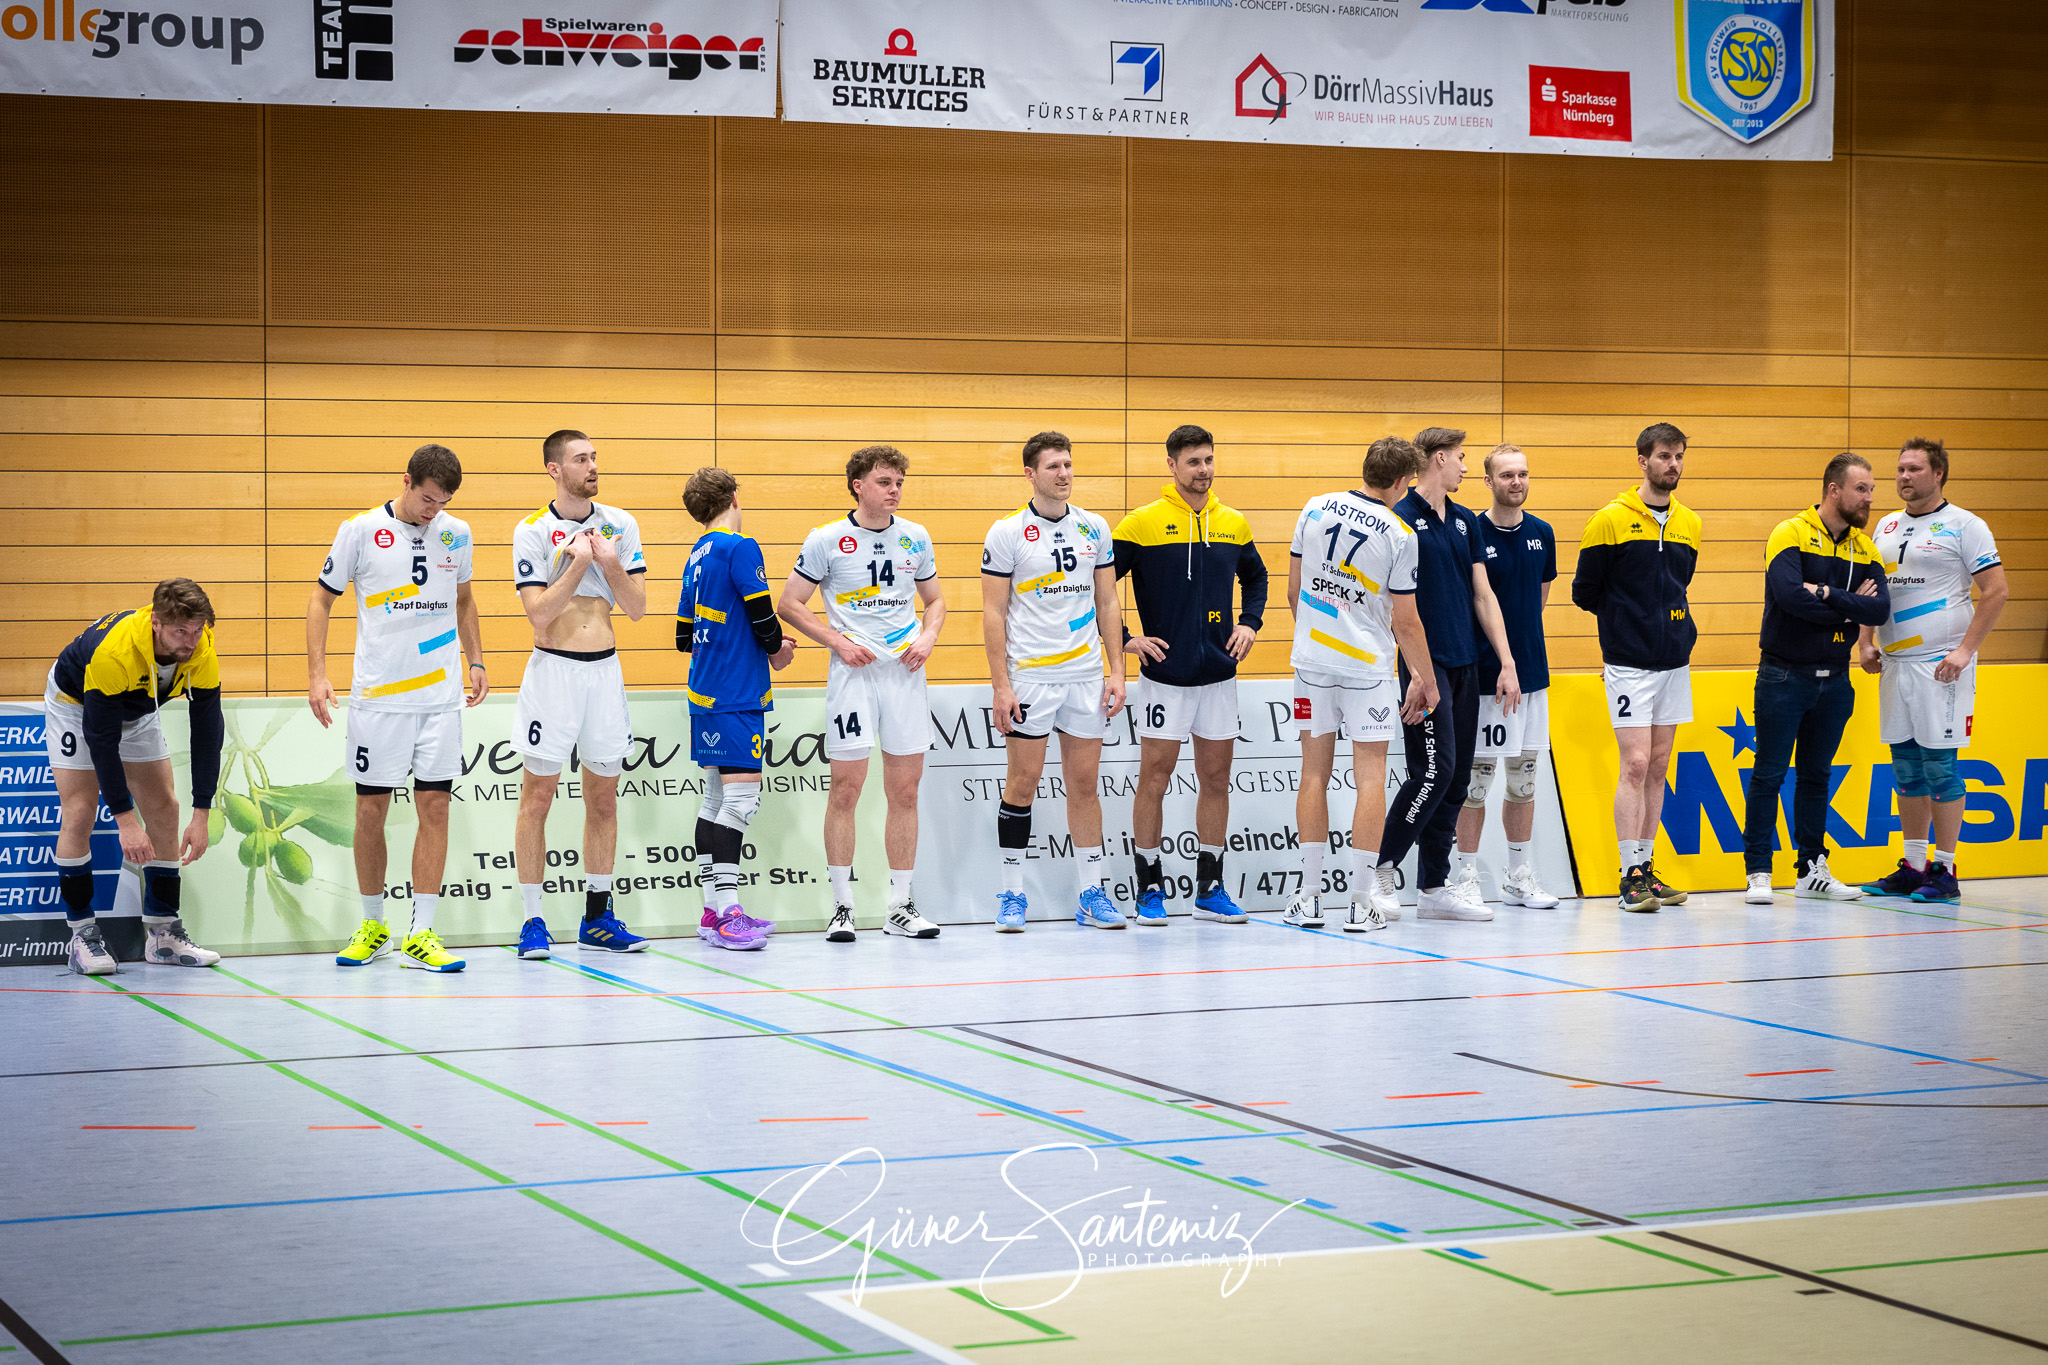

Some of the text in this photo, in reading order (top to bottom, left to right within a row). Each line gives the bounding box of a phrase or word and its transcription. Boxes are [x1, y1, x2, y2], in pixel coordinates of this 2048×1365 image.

[1240, 0, 1287, 11] CONCEPT
[1296, 2, 1329, 15] DESIGN
[1338, 5, 1399, 19] FABRICATION
[1550, 8, 1629, 23] MARKTFORSCHUNG
[545, 18, 647, 32] Spielwaren
[813, 58, 986, 89] BAUMÜLLER
[832, 85, 968, 112] SERVICES
[1314, 74, 1494, 107] DörrMassivHaus
[1562, 90, 1617, 107] Sparkasse
[1028, 102, 1189, 126] FÜRST & PARTNER
[1563, 108, 1614, 127] Nürnberg
[1740, 101, 1758, 111] 1967
[1314, 110, 1493, 128] WIR BAUEN IHR HAUS ZUM LEBEN
[1747, 119, 1763, 128] 2013
[1321, 499, 1391, 534] JASTROW
[1324, 522, 1369, 568] 17
[1526, 539, 1543, 551] MR
[1897, 540, 1909, 565] 1
[412, 555, 428, 586] 5
[1050, 546, 1077, 572] 15
[867, 559, 895, 587] 14
[1892, 576, 1926, 586] Daigfuss
[1043, 585, 1061, 594] Zapf
[1311, 577, 1351, 601] SPECK
[393, 600, 448, 611] Zapf Daigfuss
[857, 599, 876, 608] Zapf
[1670, 609, 1686, 620] MW
[1208, 611, 1221, 623] PS
[1833, 632, 1845, 643] AL
[1146, 703, 1165, 728] 16
[1617, 694, 1632, 718] 2
[528, 720, 542, 745] 6
[833, 712, 861, 739] 14
[1481, 724, 1506, 747] 10
[61, 731, 77, 757] 9
[751, 734, 762, 759] 3
[355, 746, 369, 773] 5
[1405, 720, 1438, 824] SV Schwaig Volleyball
[769, 867, 817, 885] Str.
